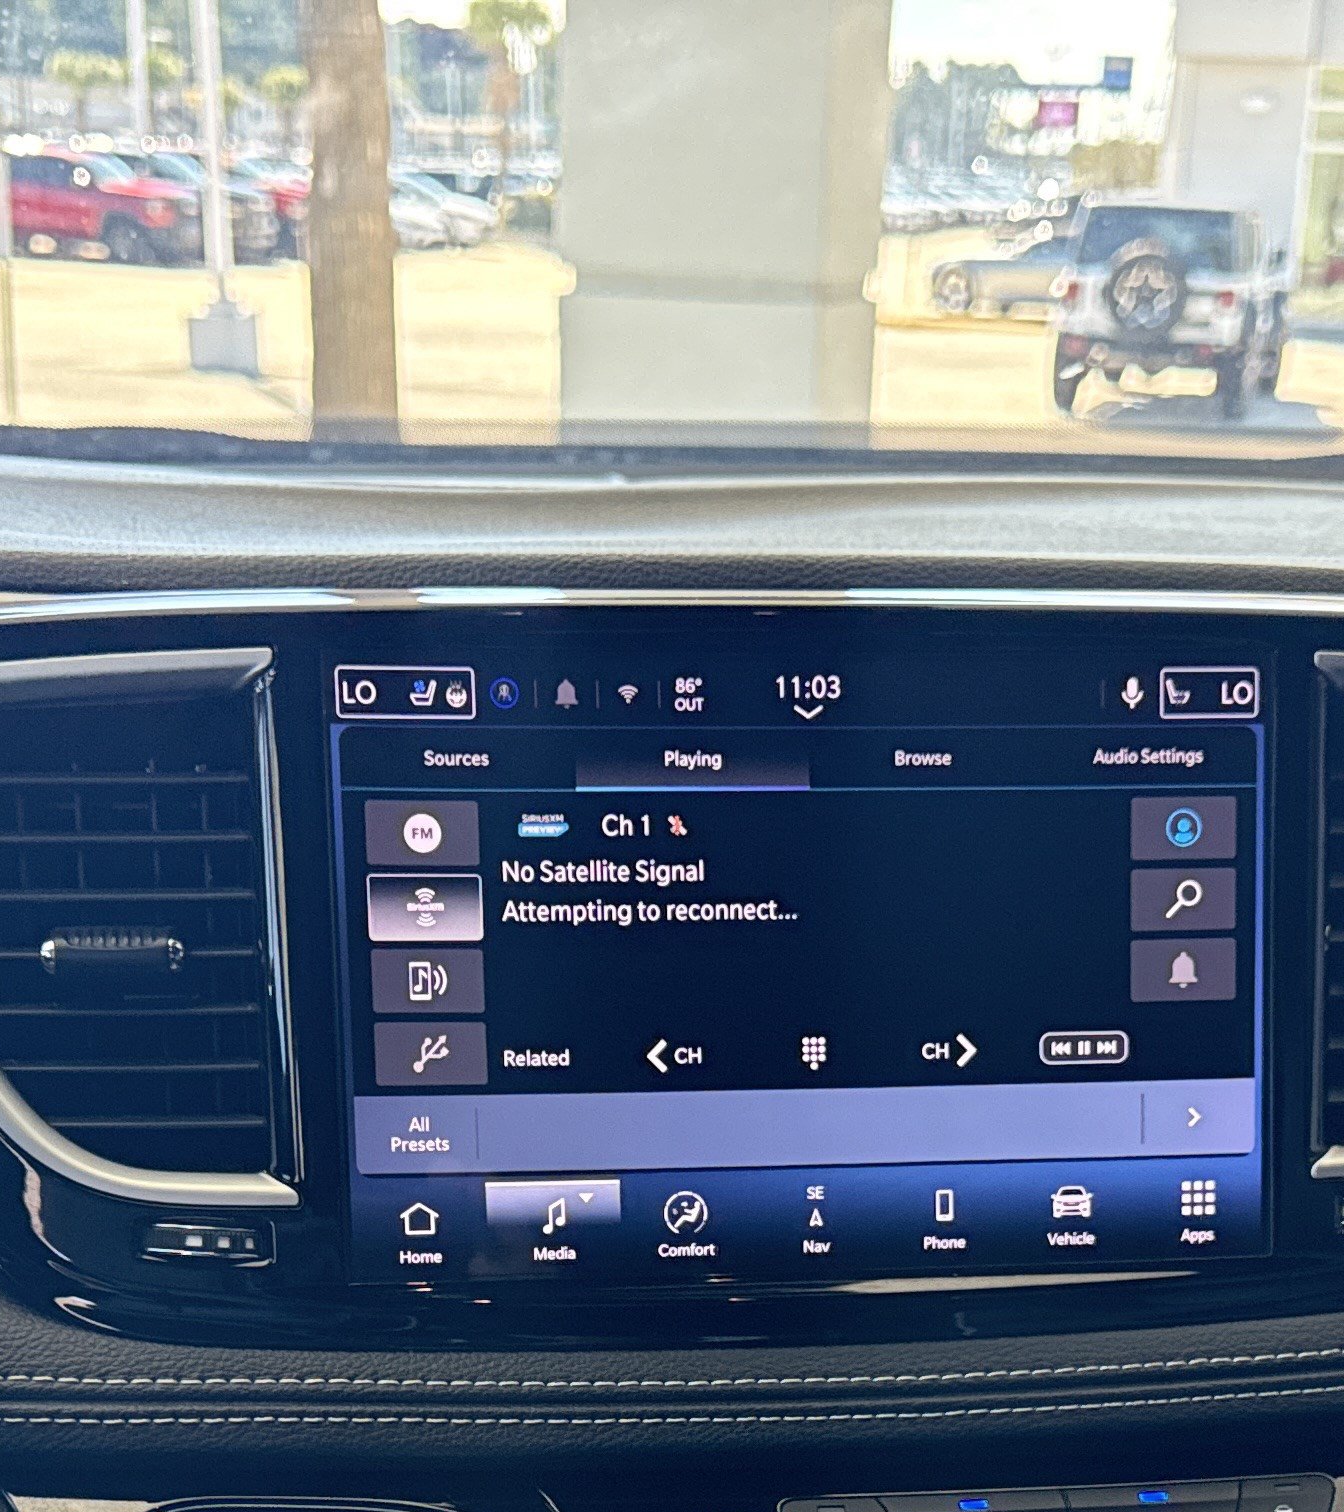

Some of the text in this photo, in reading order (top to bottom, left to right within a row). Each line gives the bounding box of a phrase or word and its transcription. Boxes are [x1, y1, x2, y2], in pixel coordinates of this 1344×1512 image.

[342, 680, 377, 705] LO
[675, 677, 703, 694] 86°
[776, 675, 841, 700] 11:03
[1221, 681, 1254, 705] LO
[675, 698, 704, 712] OUT
[423, 750, 489, 766] Sources
[664, 750, 722, 771] Playing
[894, 750, 952, 766] Browse
[1093, 747, 1204, 769] Audio Settings
[411, 827, 433, 840] FM
[601, 814, 652, 837] Ch 1
[502, 859, 705, 887] No Satellite Signal
[501, 900, 799, 926] Attempting to reconnect...
[503, 1049, 570, 1067] Related
[673, 1047, 703, 1065] CH
[921, 1042, 951, 1060] CH
[409, 1116, 430, 1133] All
[390, 1136, 450, 1153] Presets
[806, 1186, 825, 1201] SE
[923, 1235, 967, 1250] Phone
[1046, 1232, 1096, 1247] Vehicle
[1180, 1228, 1216, 1245] Apps
[533, 1246, 577, 1261] Media
[658, 1242, 716, 1258] Comfort
[802, 1240, 831, 1254] Nav
[399, 1250, 443, 1265] Home
